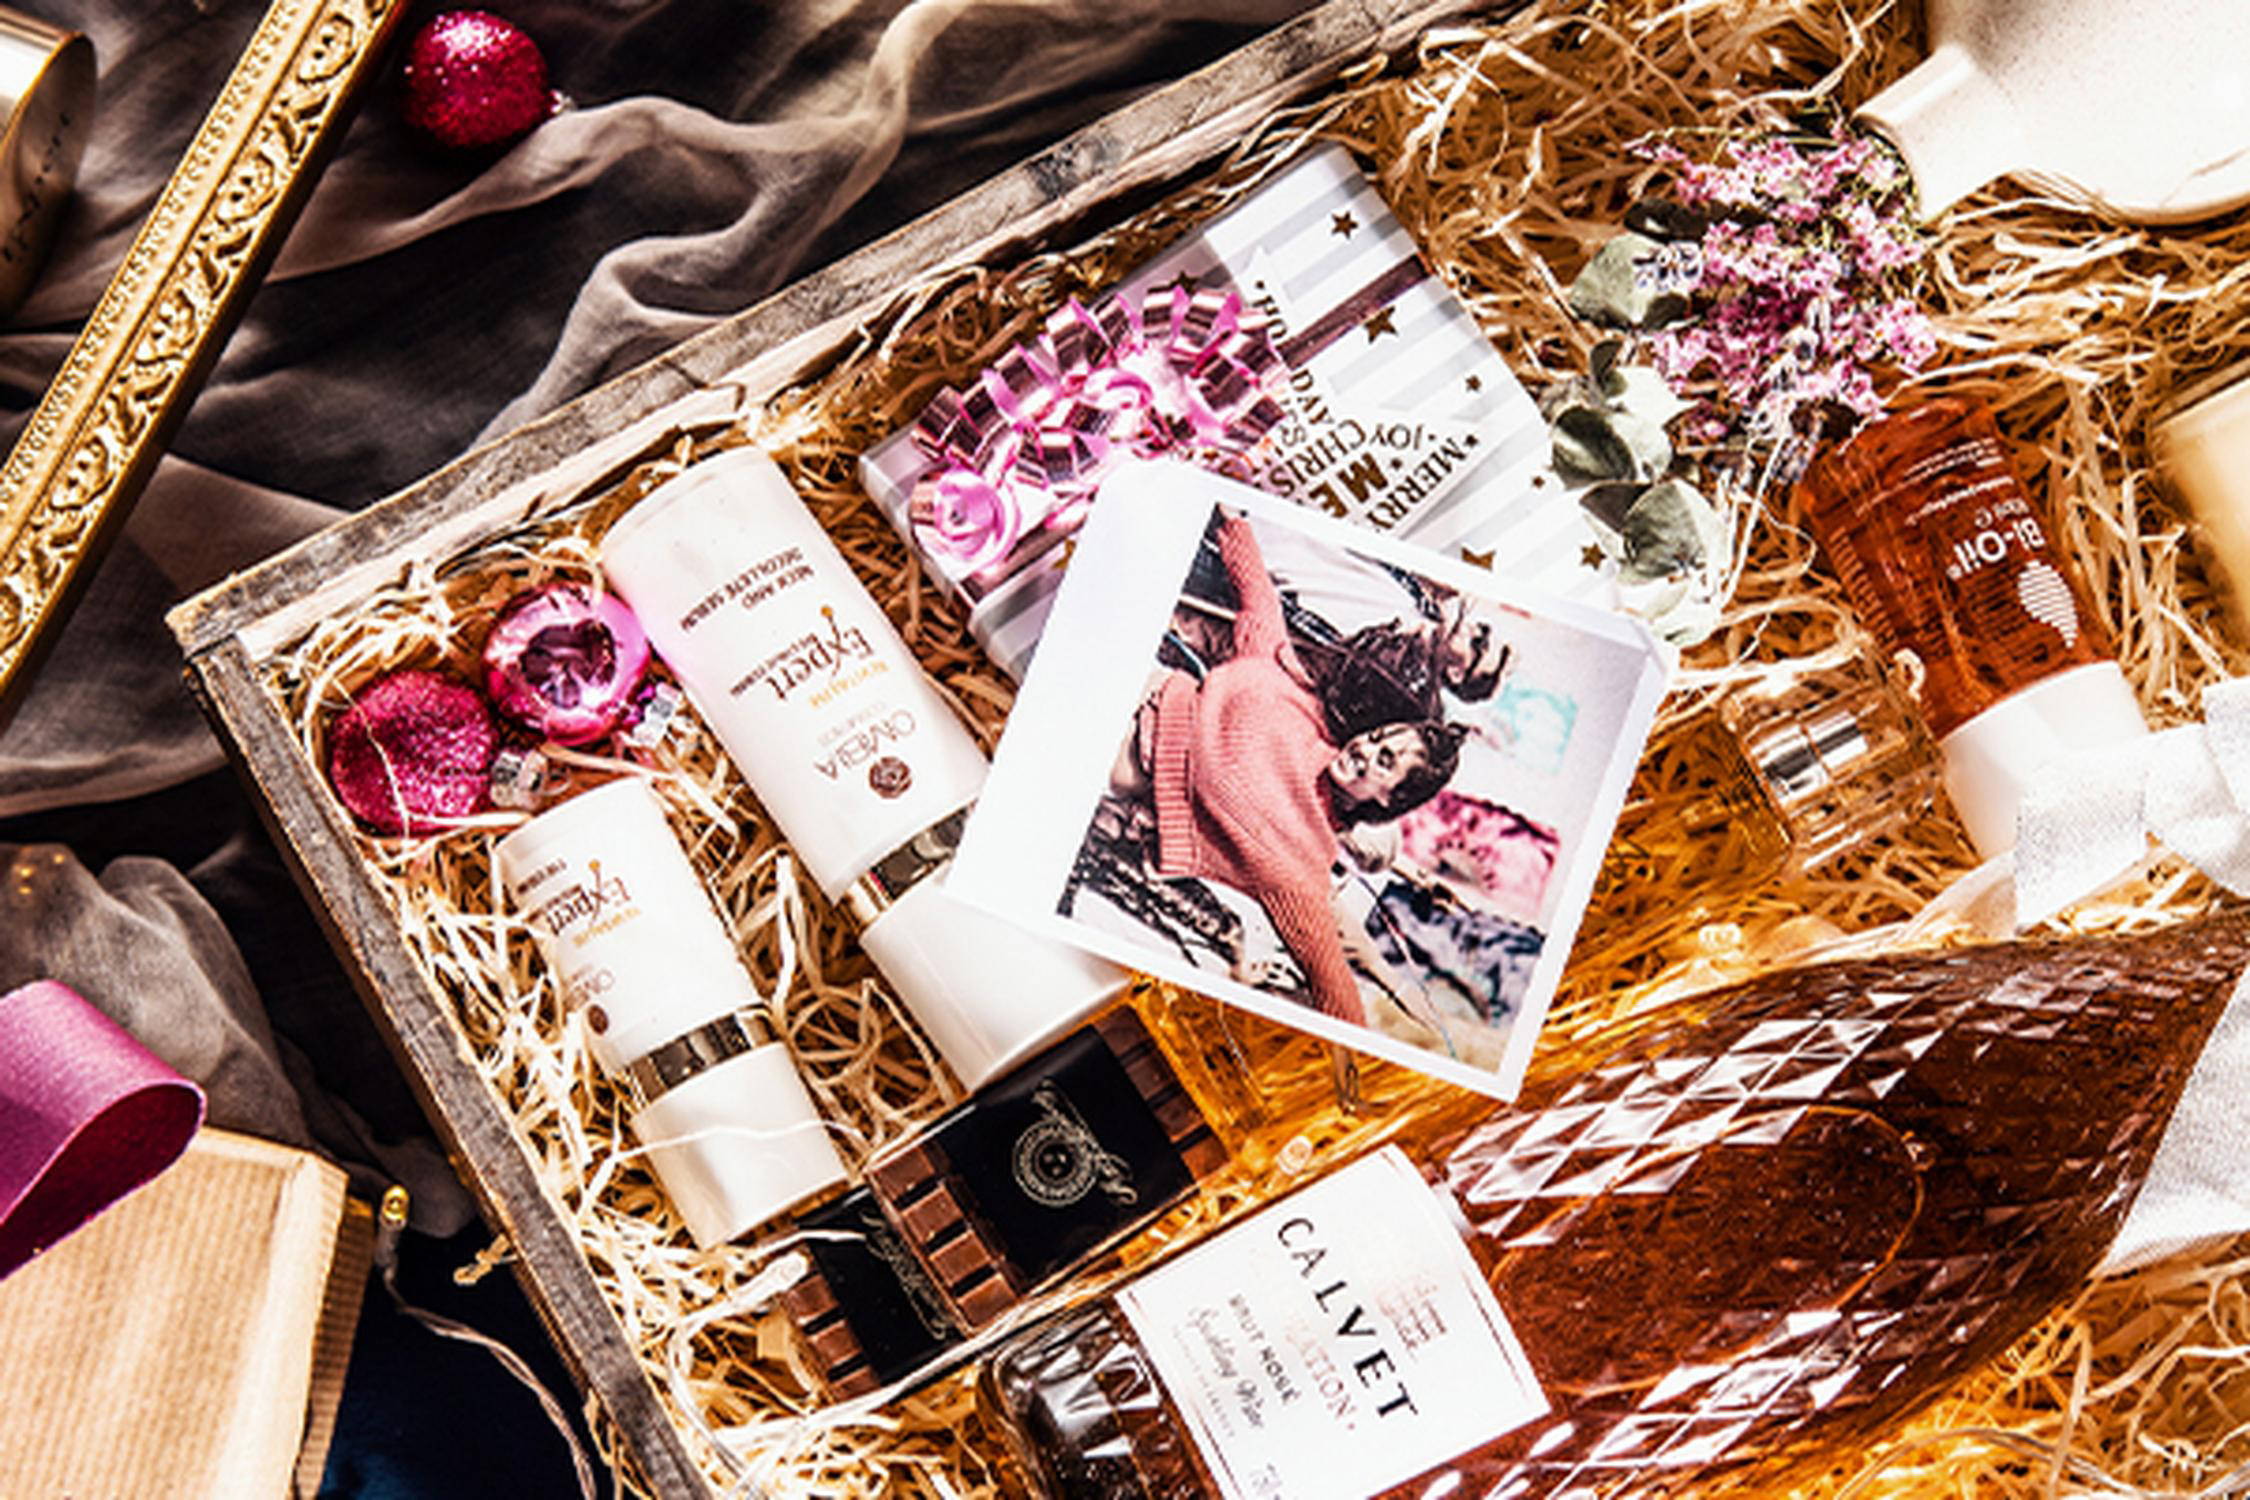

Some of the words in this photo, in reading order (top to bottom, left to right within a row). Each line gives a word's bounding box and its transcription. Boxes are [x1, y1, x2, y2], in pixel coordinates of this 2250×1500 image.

[1251, 294, 1334, 425] HODAY
[1267, 418, 1367, 499] CHRIS
[1308, 451, 1389, 519] ME
[1366, 438, 1468, 531] MERRY
[765, 620, 875, 701] Expert
[1277, 1217, 1419, 1419] CALVET
